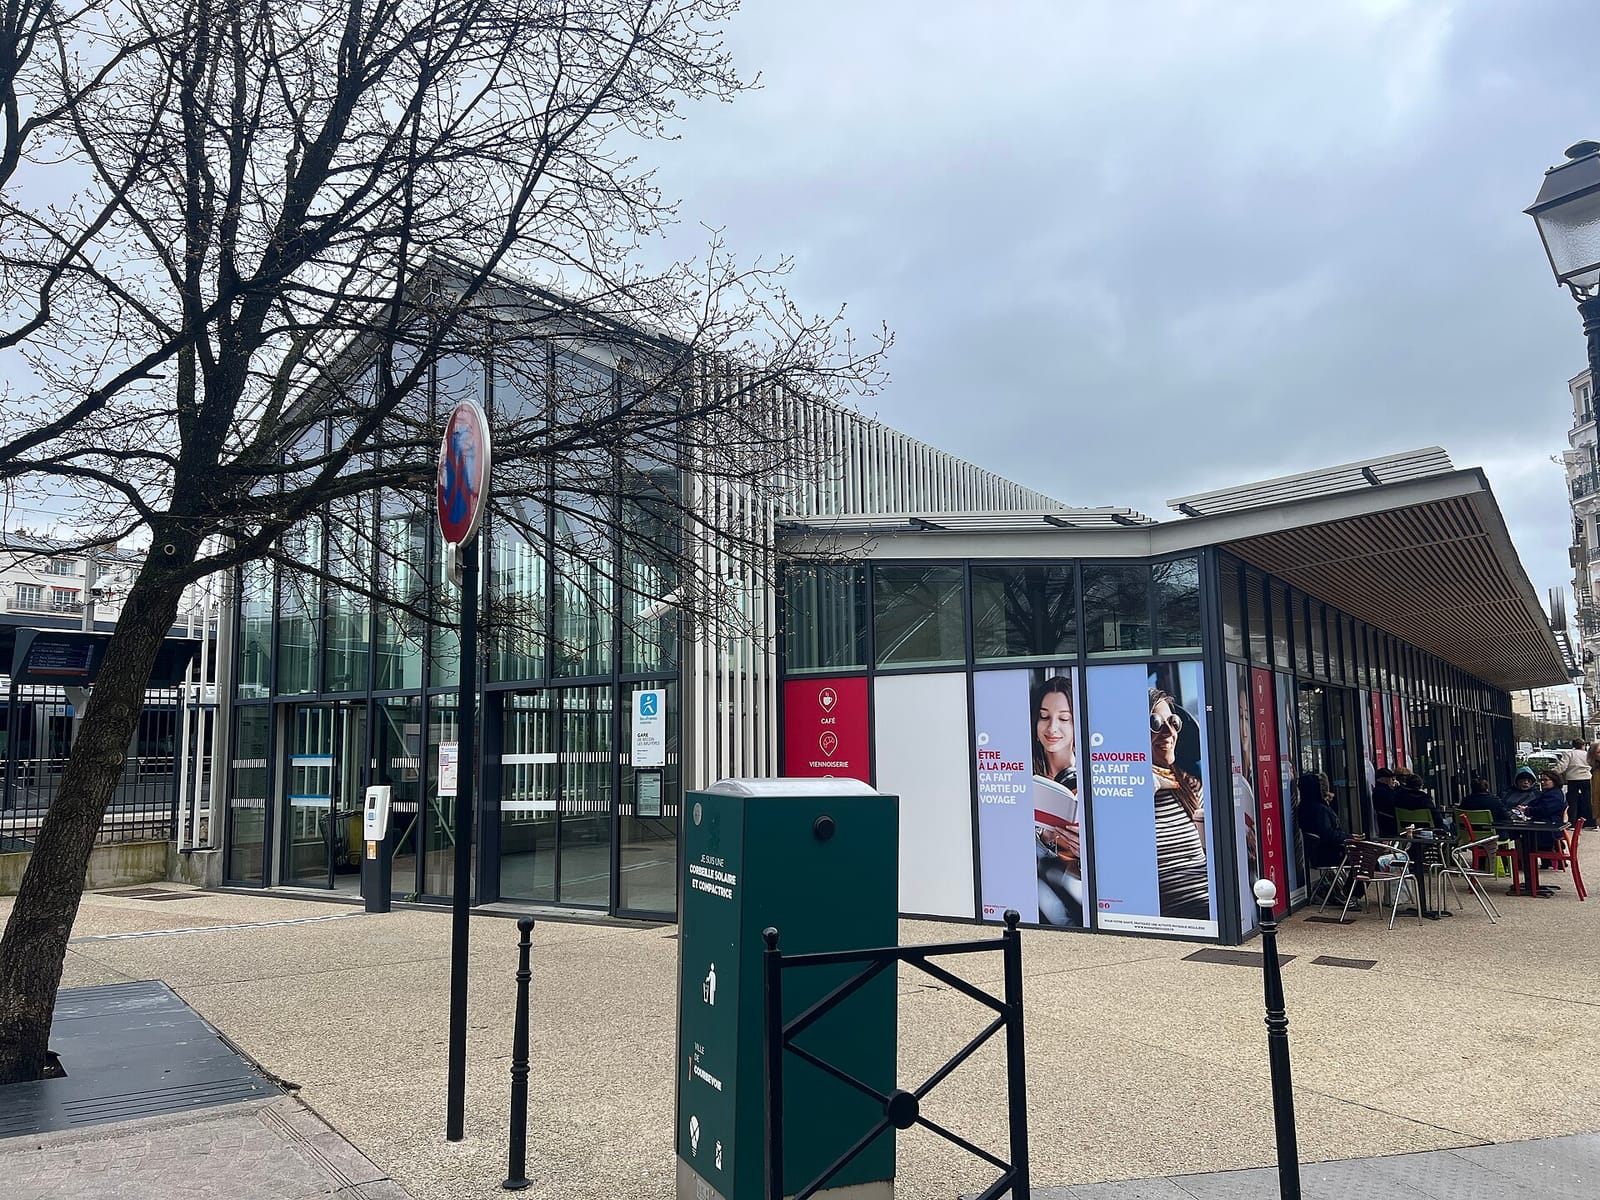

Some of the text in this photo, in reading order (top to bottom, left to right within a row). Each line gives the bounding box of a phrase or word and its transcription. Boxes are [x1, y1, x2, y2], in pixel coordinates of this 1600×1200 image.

[978, 749, 1001, 760] ÊTRE
[1091, 752, 1146, 761] SAVOURER
[979, 760, 1024, 771] À LA PAGE
[1092, 764, 1130, 775] ÇA FAIT
[980, 773, 1013, 784] ÇA FAIT
[1092, 776, 1145, 785] PARTIE DU
[980, 784, 1026, 793] PARTIE DU
[1093, 787, 1134, 797] VOYAGE
[980, 795, 1017, 805] VOYAGE
[689, 864, 736, 885] CORBEILLE SOLAIRE
[692, 878, 732, 899] ET COMPACTRICE
[693, 1064, 722, 1092] COURBEVOIE
